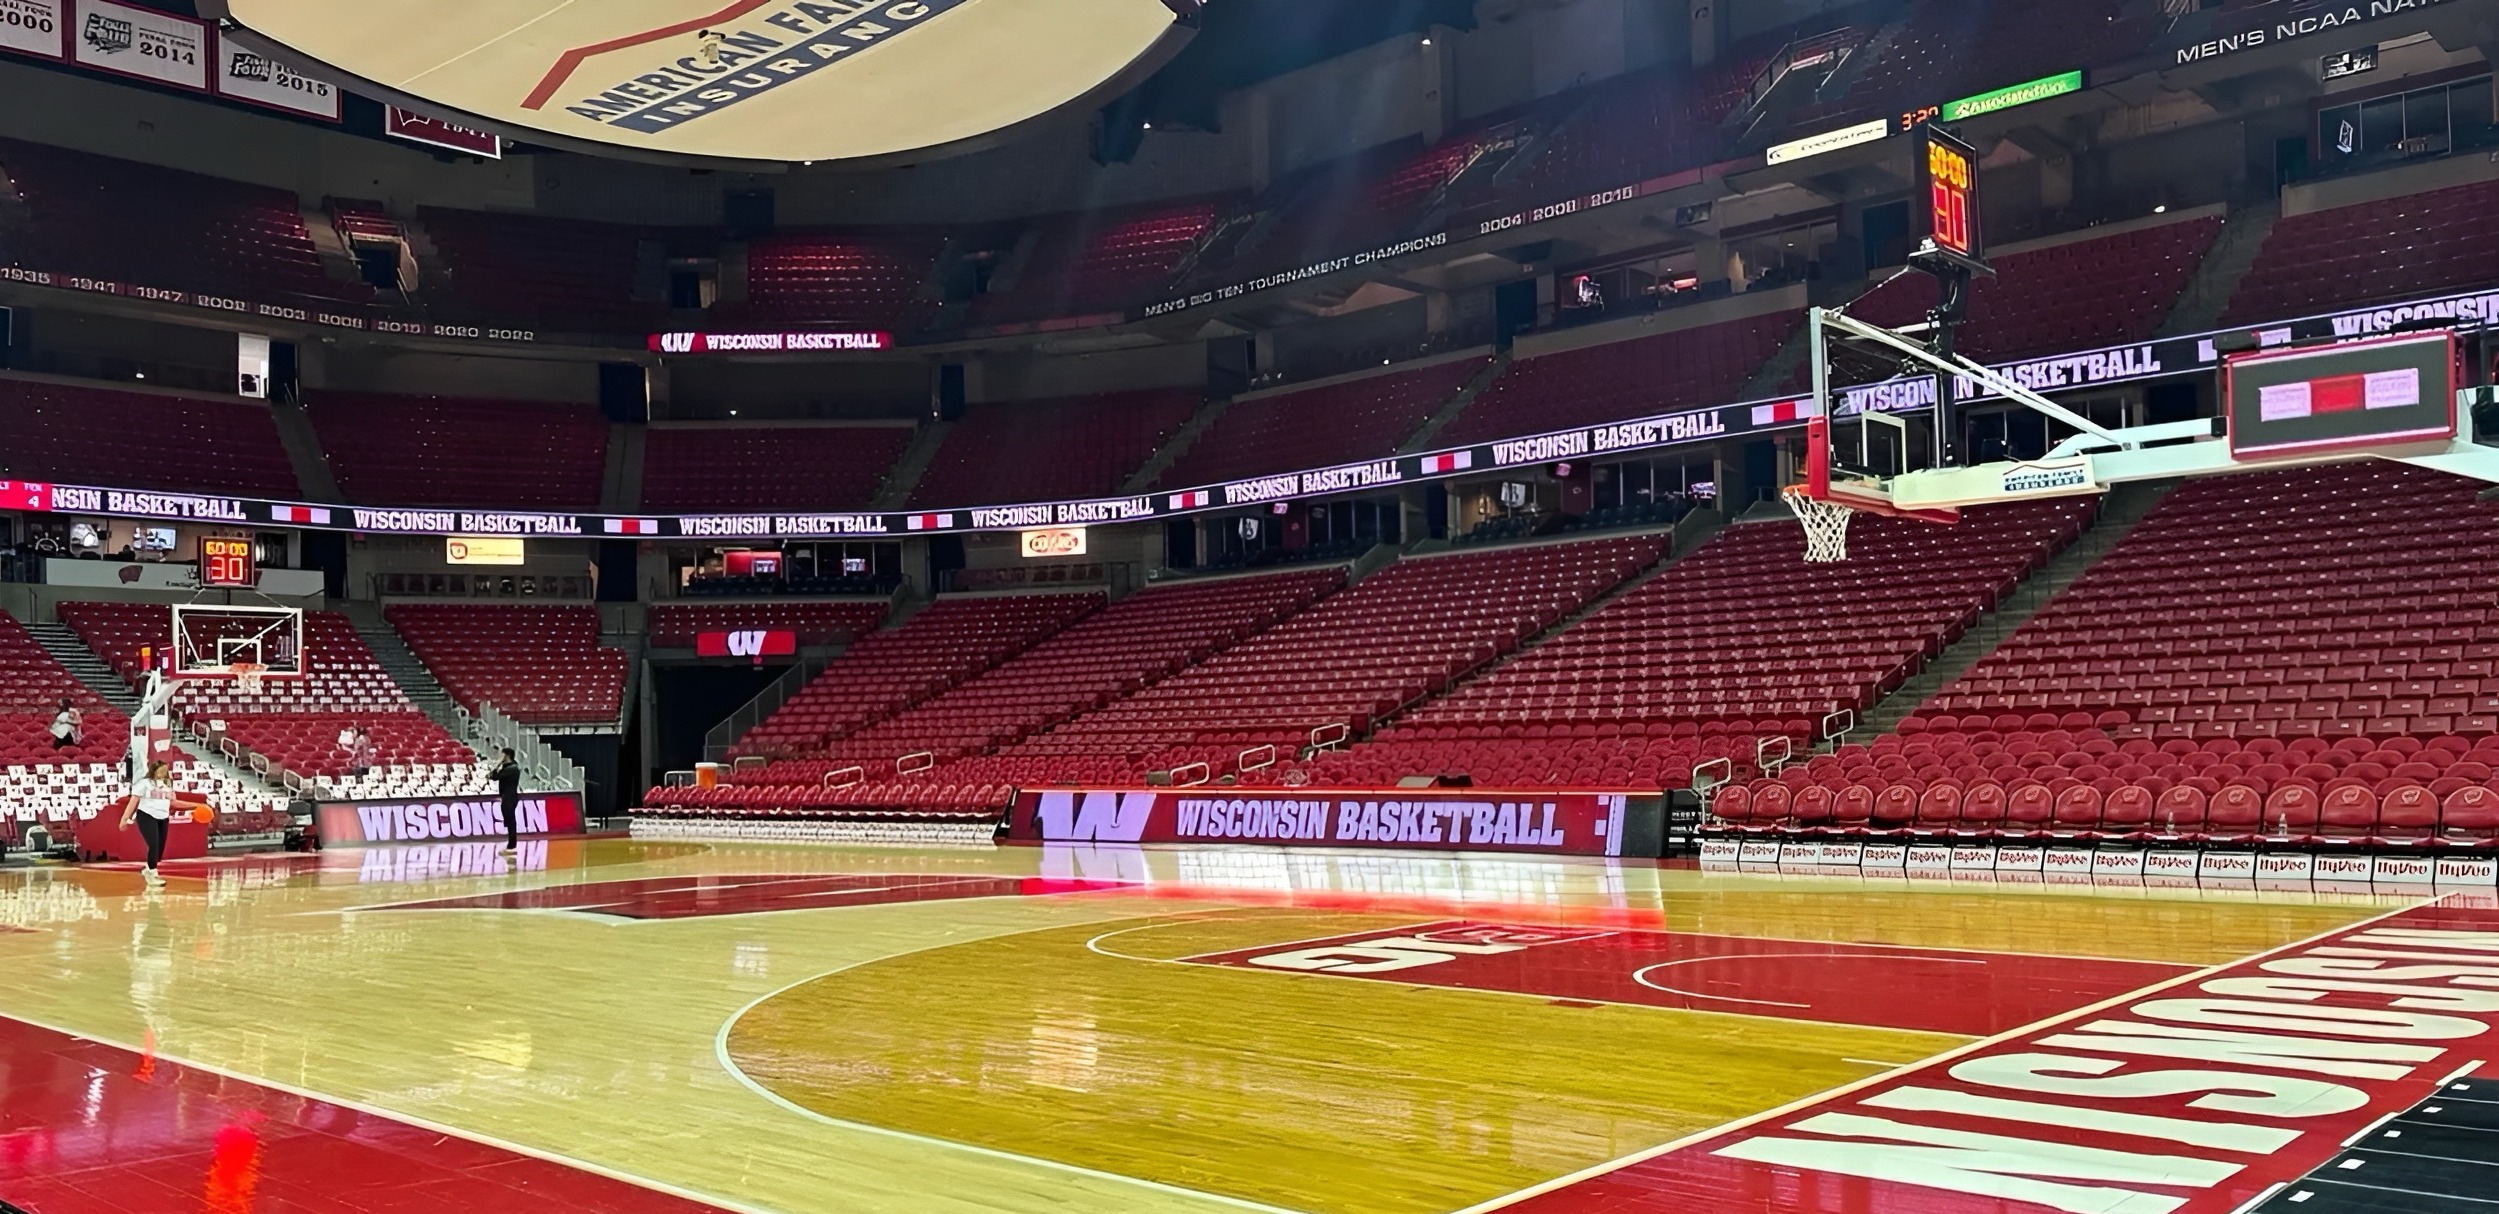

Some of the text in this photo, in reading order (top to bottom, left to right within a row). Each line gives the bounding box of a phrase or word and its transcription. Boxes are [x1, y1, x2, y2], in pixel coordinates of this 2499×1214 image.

[2177, 30, 2264, 63] MEN'S
[2277, 7, 2361, 40] NCAA
[140, 42, 195, 65] 2014
[277, 73, 329, 97] 2015
[565, 30, 784, 122] AMERICAN
[1249, 257, 1349, 292] TOURNAMENT
[1354, 232, 1447, 265] CHAMPIONS
[706, 334, 782, 350] WISCONSIN
[787, 333, 881, 349] BASKETBALL
[1846, 374, 1974, 415] WISCONIN
[1492, 411, 1725, 465] WISCONSIN BASKETBALL
[1225, 460, 1401, 503] WISCONSIN BASKETBALL
[108, 492, 246, 520] BASKETBALL
[353, 509, 581, 533] WISCONSIN BASKETBALL
[971, 497, 1154, 527] WISCONSIN BASKETBALL
[679, 516, 887, 535] WISCONSIN BASKETBALL
[211, 556, 244, 581] 30
[357, 800, 549, 841] WISCONSIN
[1177, 800, 1330, 839] WISCONSIN
[1336, 801, 1564, 846] BASKETBALL
